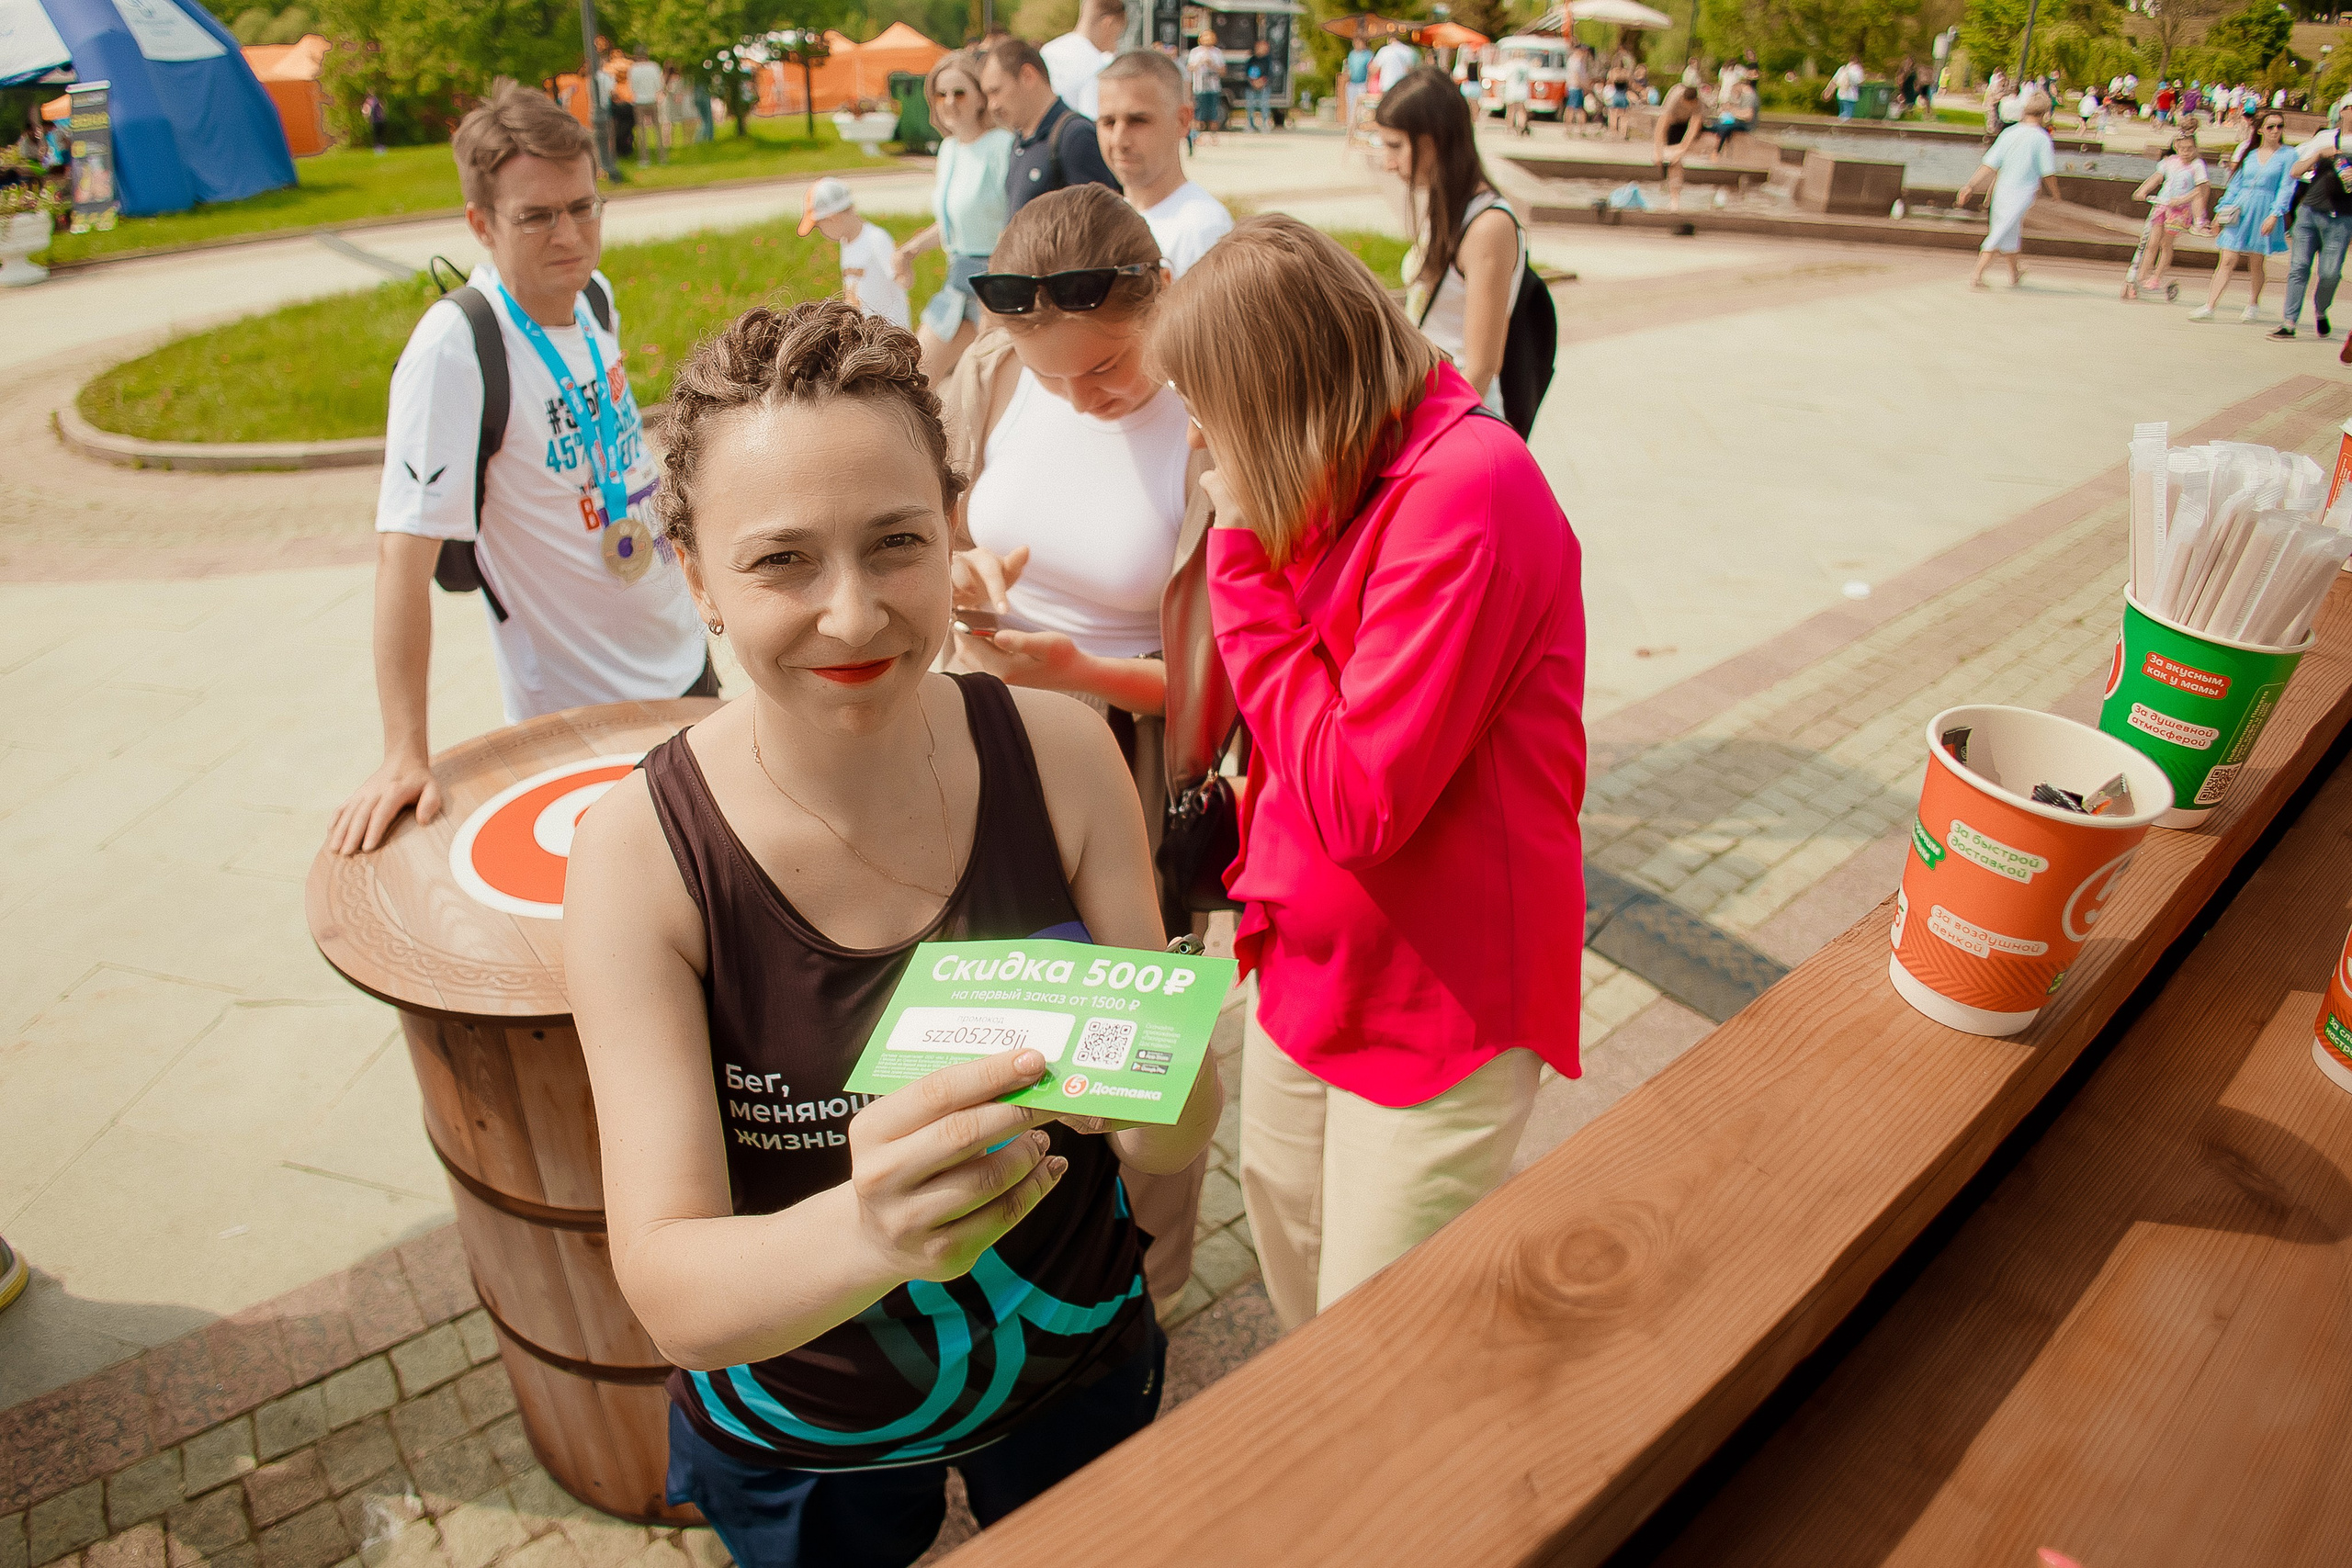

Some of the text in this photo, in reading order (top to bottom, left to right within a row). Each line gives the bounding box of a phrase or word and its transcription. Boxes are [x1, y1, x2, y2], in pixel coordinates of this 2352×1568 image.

[2146, 666, 2219, 696] как у мамы
[2149, 654, 2224, 687] За вкусным,
[2132, 716, 2206, 747] атмосферой
[2134, 705, 2213, 738] За душевной
[1951, 835, 2028, 879] доставкой
[1953, 823, 1970, 839] За
[1973, 835, 2040, 869] быстрой
[1932, 921, 1984, 953] пенкой
[1934, 908, 2041, 953] За воздушной
[932, 952, 1076, 984] Скидка
[951, 988, 969, 1000] на
[969, 987, 1023, 1003] первый
[1023, 993, 1066, 1005] заказ
[1069, 995, 1088, 1007] от
[956, 1015, 1005, 1024] промокод
[2329, 1017, 2340, 1031] За
[922, 1026, 1029, 1050] szz05278jj
[725, 1063, 790, 1098] Бег,
[1089, 1081, 1162, 1100] Доставка
[733, 1128, 847, 1150] жизнь
